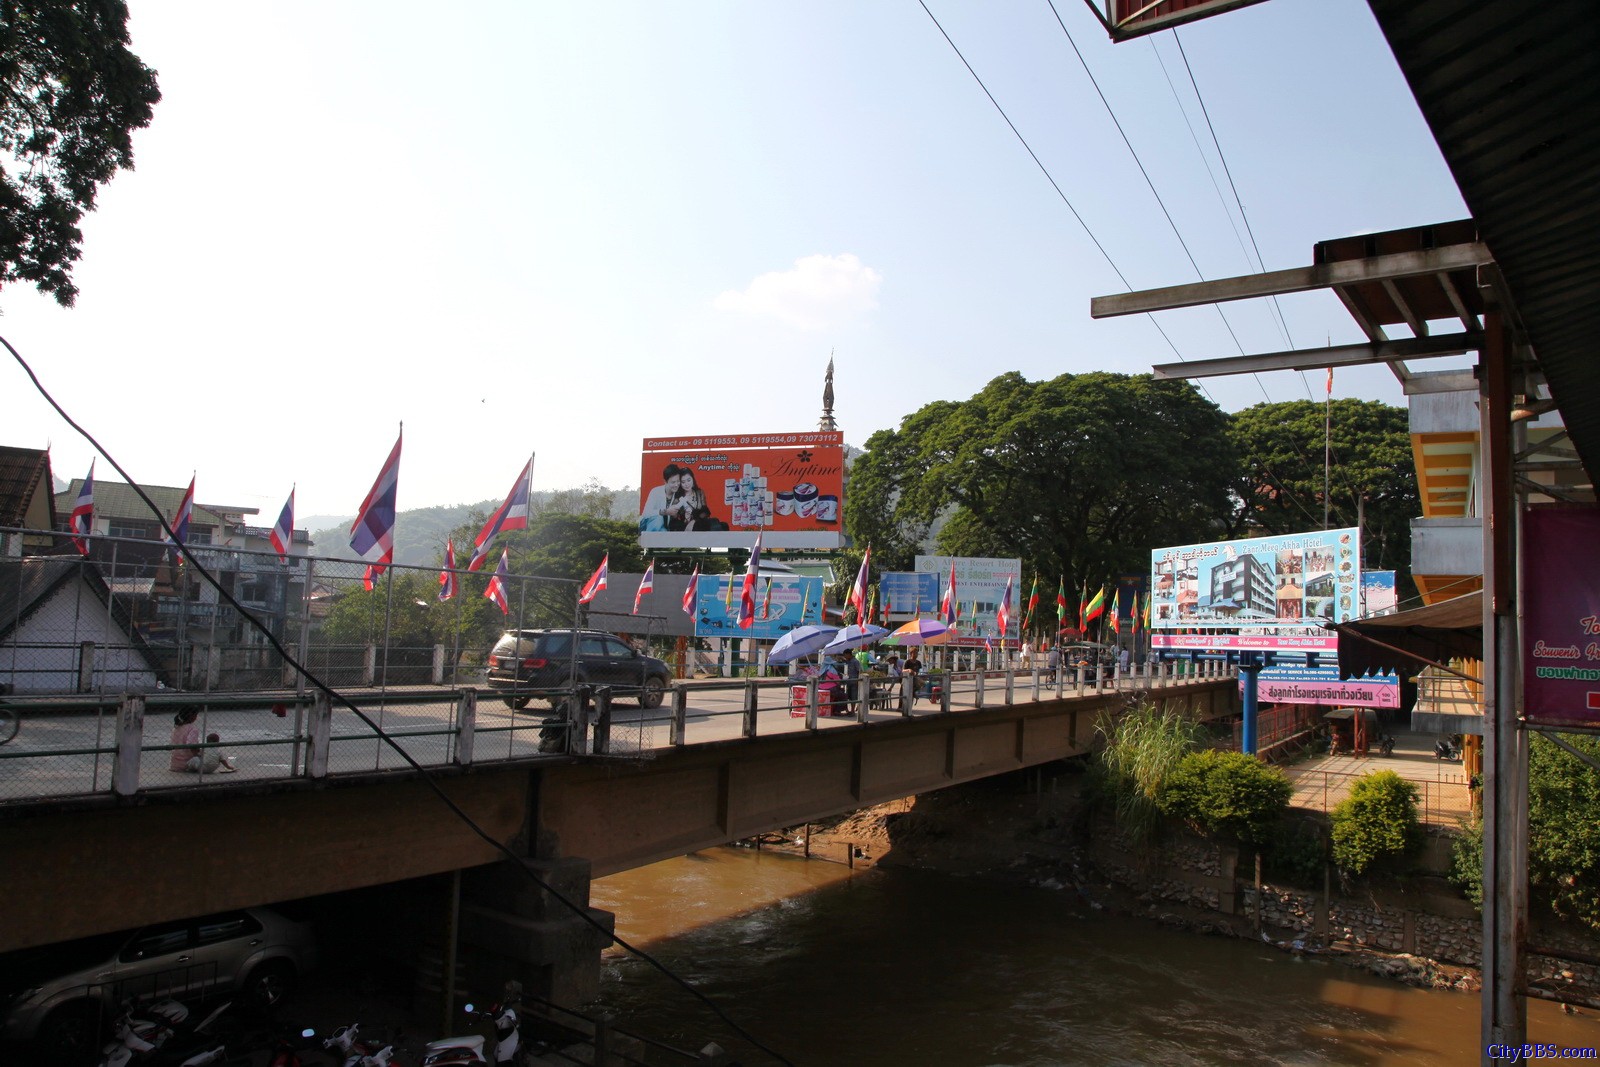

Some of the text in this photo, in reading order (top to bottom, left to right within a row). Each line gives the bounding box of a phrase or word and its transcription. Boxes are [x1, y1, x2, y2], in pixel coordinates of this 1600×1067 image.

[799, 434, 838, 442] 73073112
[767, 456, 841, 484] Anytime
[1281, 540, 1300, 550] Akha
[1303, 537, 1322, 548] Hotel
[969, 559, 994, 567] Resort
[998, 560, 1018, 568] Hotel
[1237, 637, 1262, 646] Welcome
[1263, 638, 1270, 646] to
[1533, 640, 1581, 659] Souvenir
[1536, 666, 1600, 681] ของฝากจ
